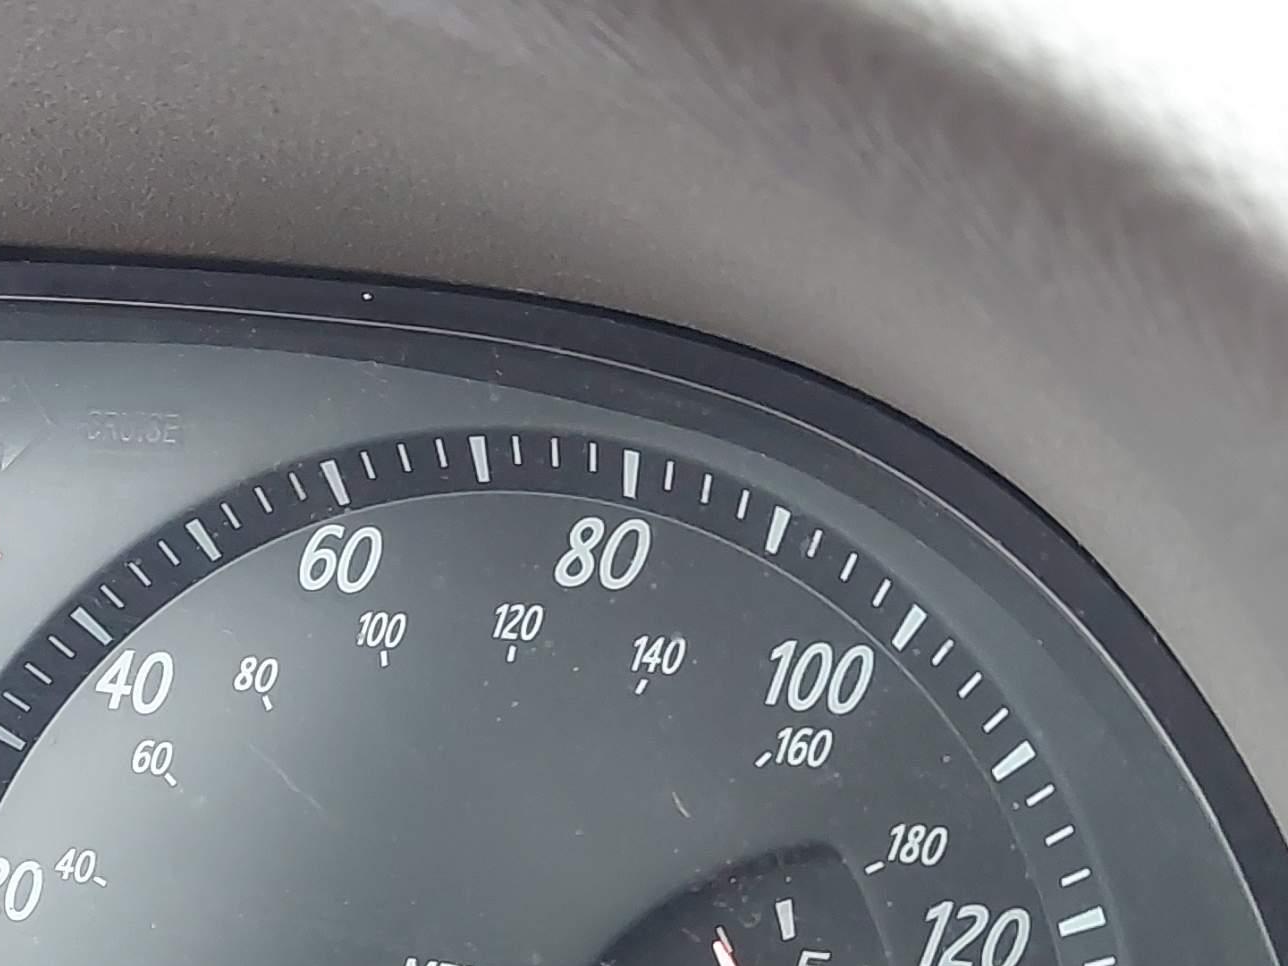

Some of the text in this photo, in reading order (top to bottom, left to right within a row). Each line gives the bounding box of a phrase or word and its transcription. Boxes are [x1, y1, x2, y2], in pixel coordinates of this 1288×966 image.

[298, 523, 384, 595] 60
[553, 516, 652, 591] 80
[356, 611, 408, 649] 100
[492, 602, 544, 642] 120
[233, 656, 280, 693] 80
[631, 635, 686, 676] 140
[95, 649, 175, 715] 40
[764, 640, 876, 717] 100
[131, 739, 174, 776] 60
[774, 727, 834, 769] 160
[55, 848, 97, 884] 40
[886, 824, 949, 867] 180
